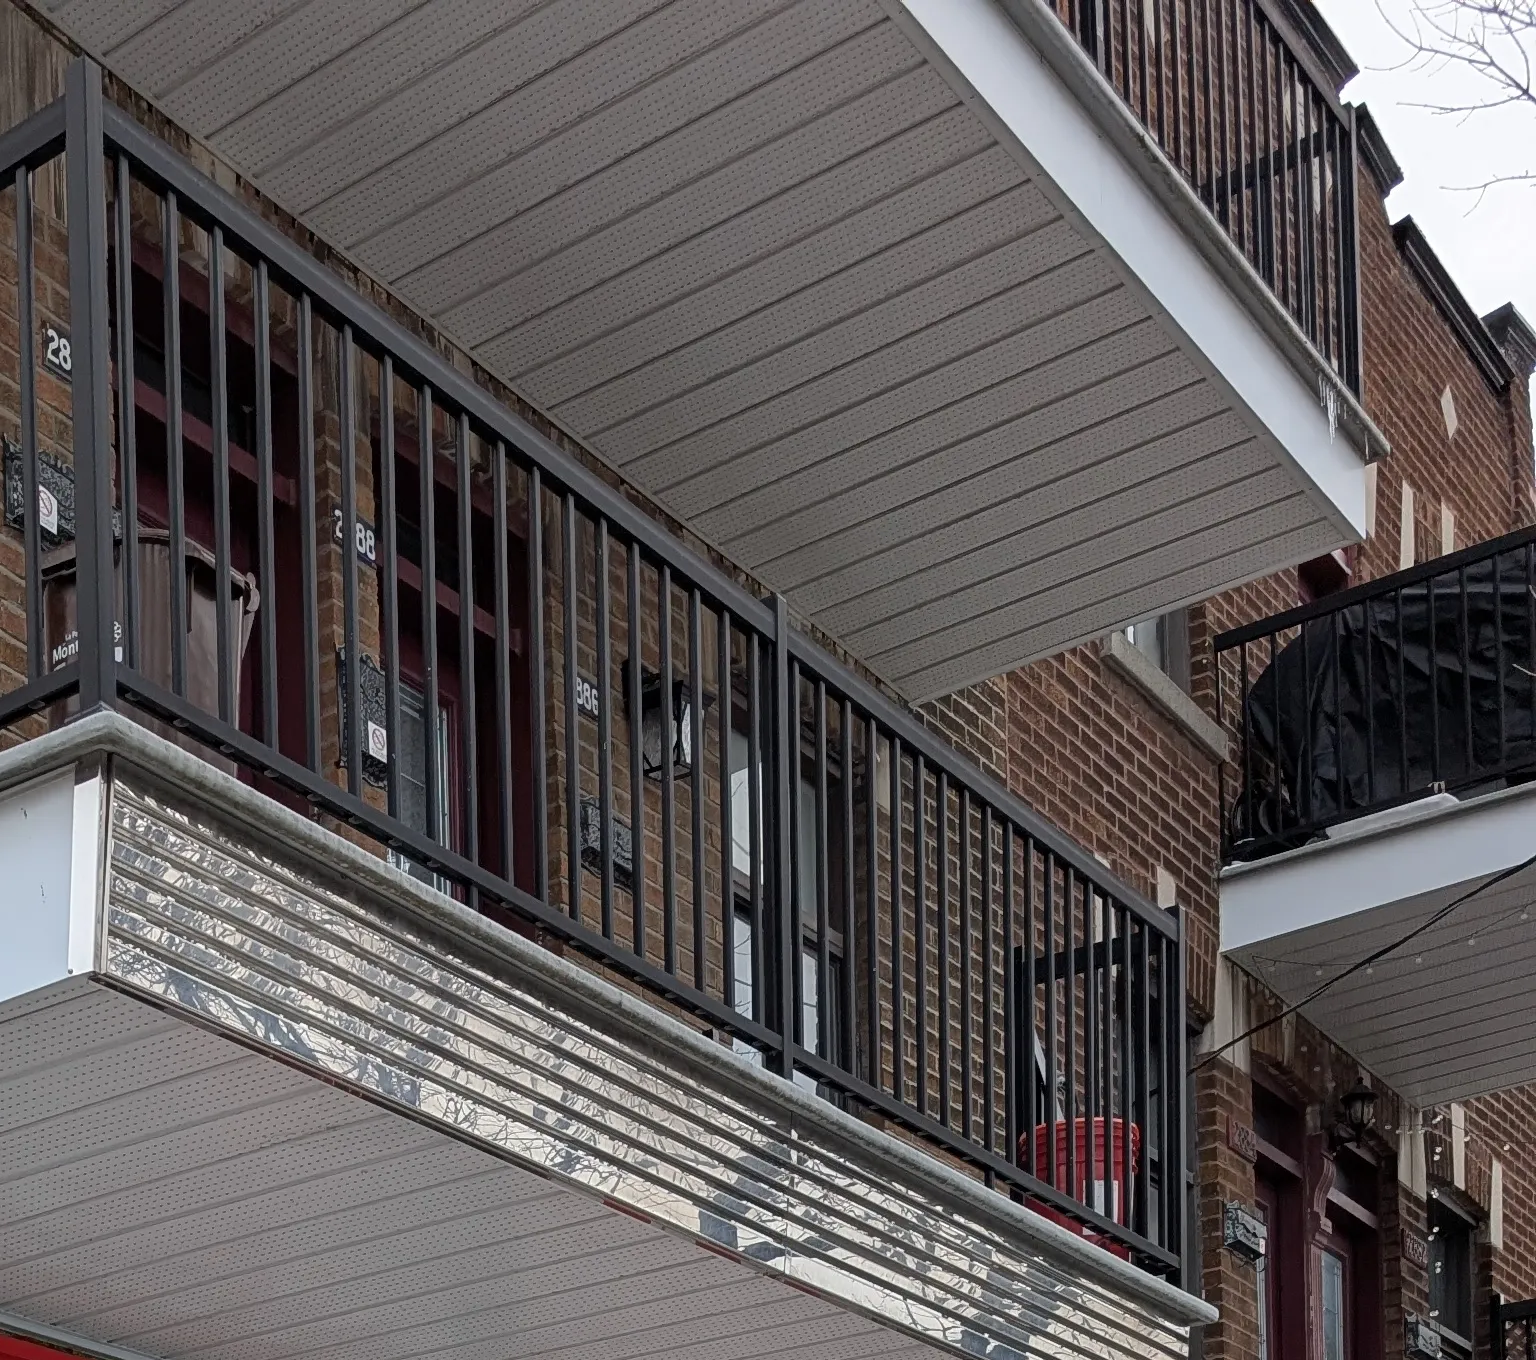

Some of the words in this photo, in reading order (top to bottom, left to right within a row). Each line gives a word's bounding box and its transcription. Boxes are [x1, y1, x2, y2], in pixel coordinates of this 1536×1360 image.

[47, 328, 72, 371] 28
[334, 509, 376, 561] 288
[576, 676, 599, 716] 886
